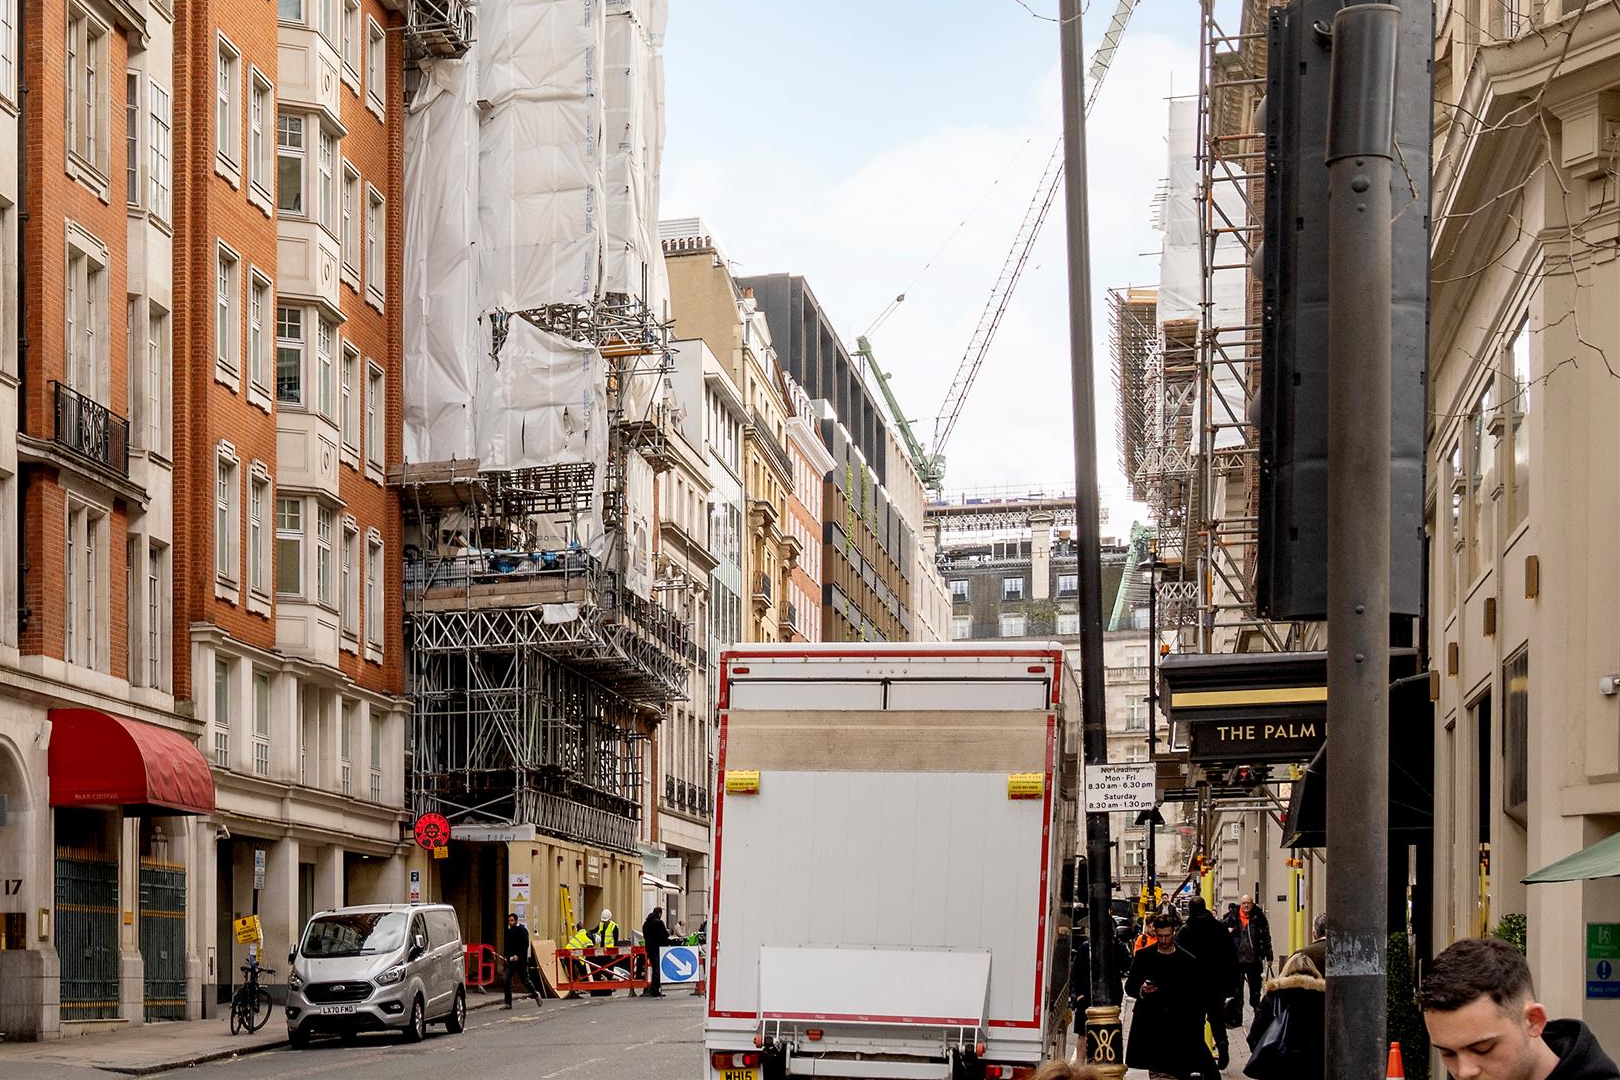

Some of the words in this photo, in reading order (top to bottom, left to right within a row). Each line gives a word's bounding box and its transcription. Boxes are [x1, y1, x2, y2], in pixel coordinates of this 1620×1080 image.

[1217, 726, 1255, 741] THE
[1264, 723, 1316, 739] PALM
[5, 879, 23, 895] 17
